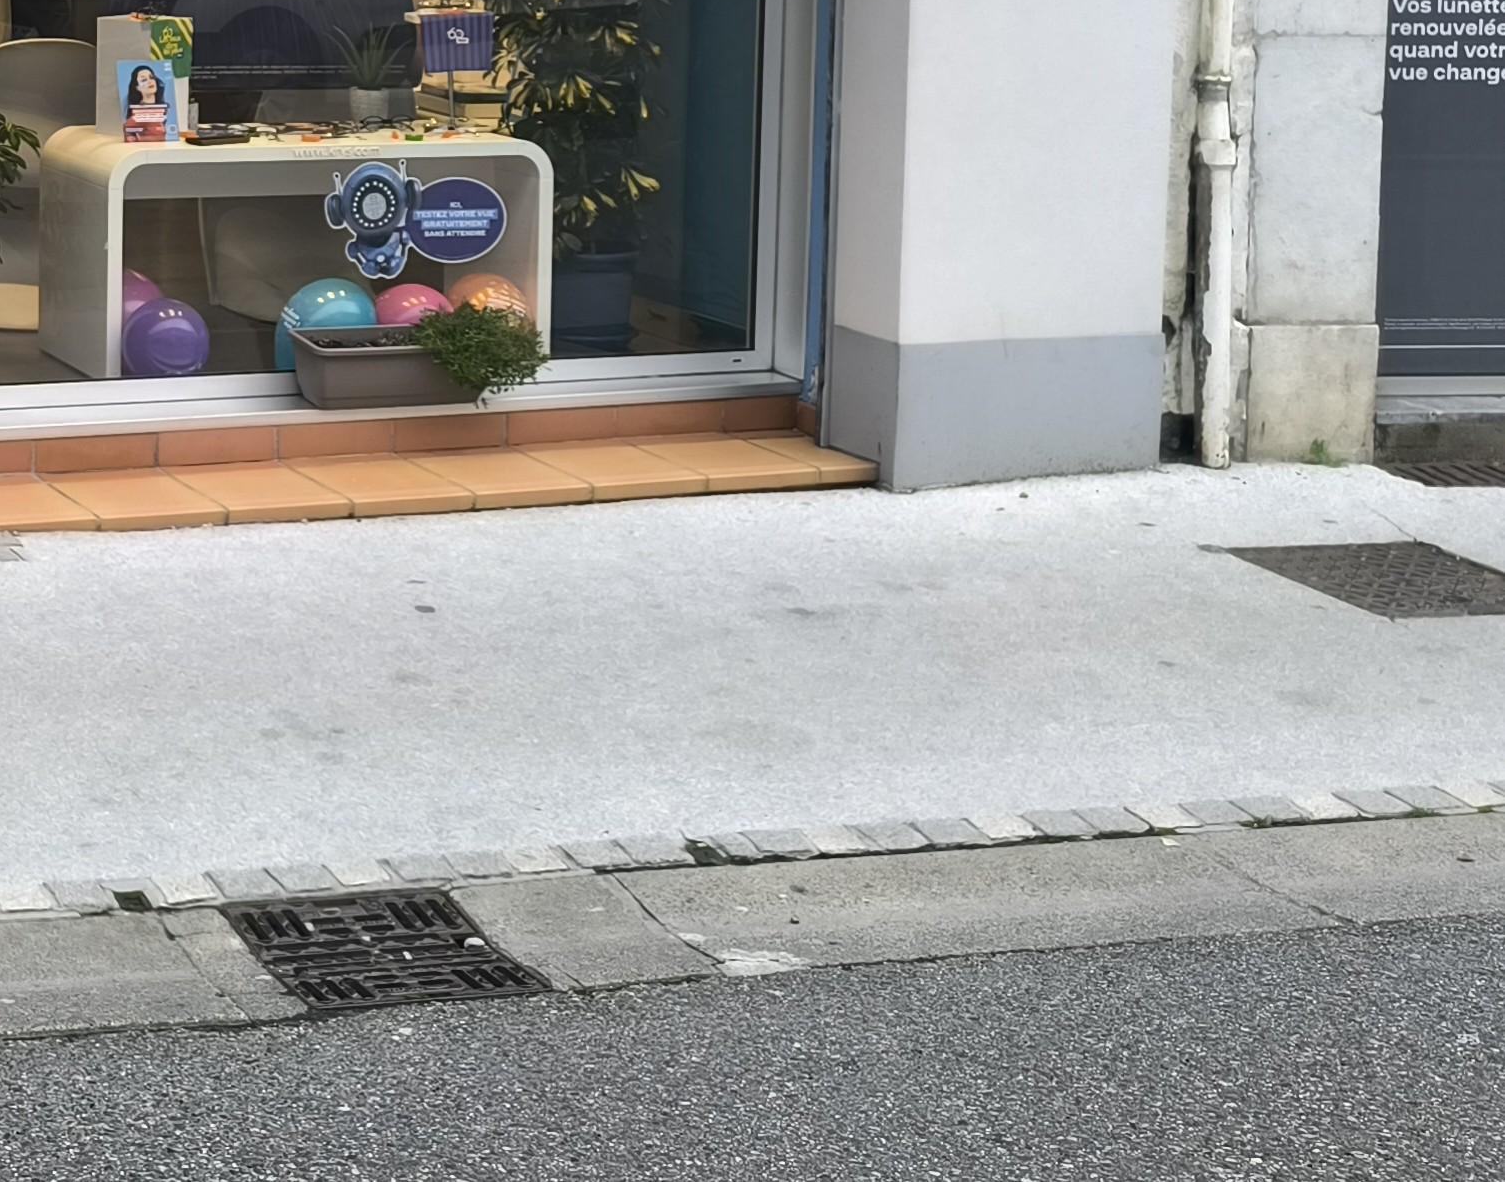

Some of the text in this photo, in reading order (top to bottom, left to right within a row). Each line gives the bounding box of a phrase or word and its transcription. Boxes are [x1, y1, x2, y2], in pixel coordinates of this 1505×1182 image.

[1391, 18, 1505, 36] renouvelée
[1389, 41, 1505, 62] quand votr
[1389, 67, 1428, 81] vue
